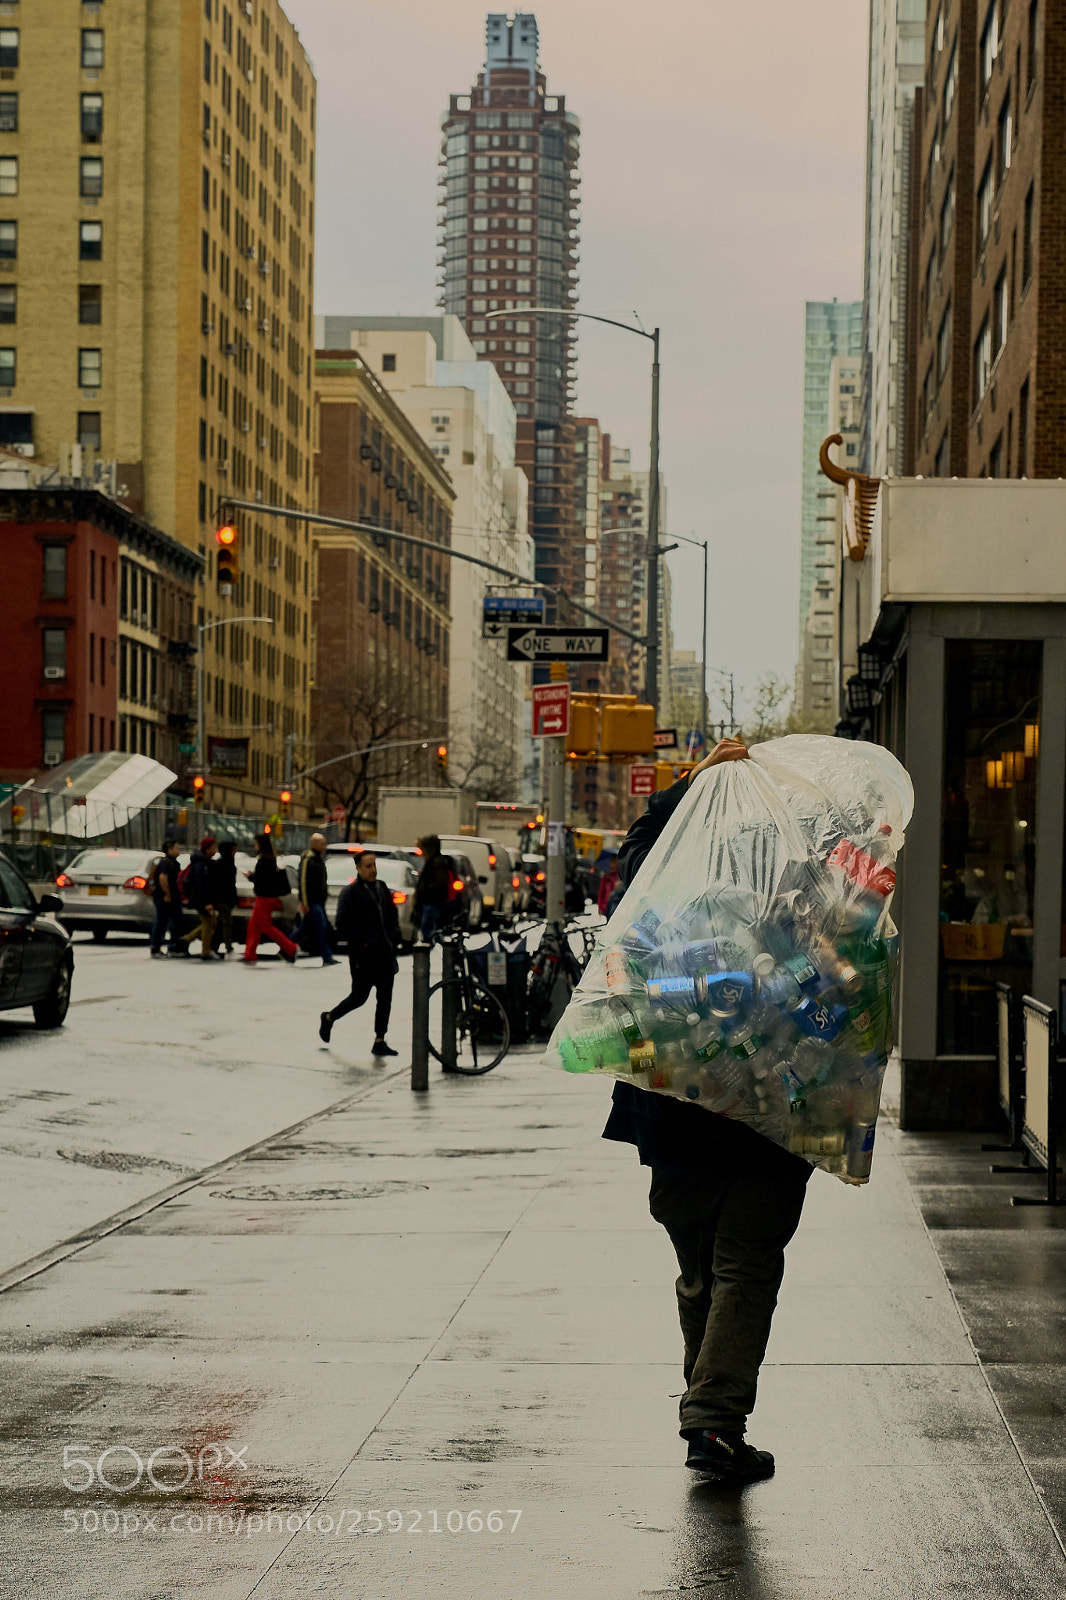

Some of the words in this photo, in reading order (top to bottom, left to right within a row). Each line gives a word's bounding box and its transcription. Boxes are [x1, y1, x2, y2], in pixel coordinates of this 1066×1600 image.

[522, 637, 551, 652] ONE
[565, 638, 596, 652] WAY
[535, 690, 542, 701] NO
[543, 688, 567, 701] STANDING
[716, 1437, 734, 1455] Reebok
